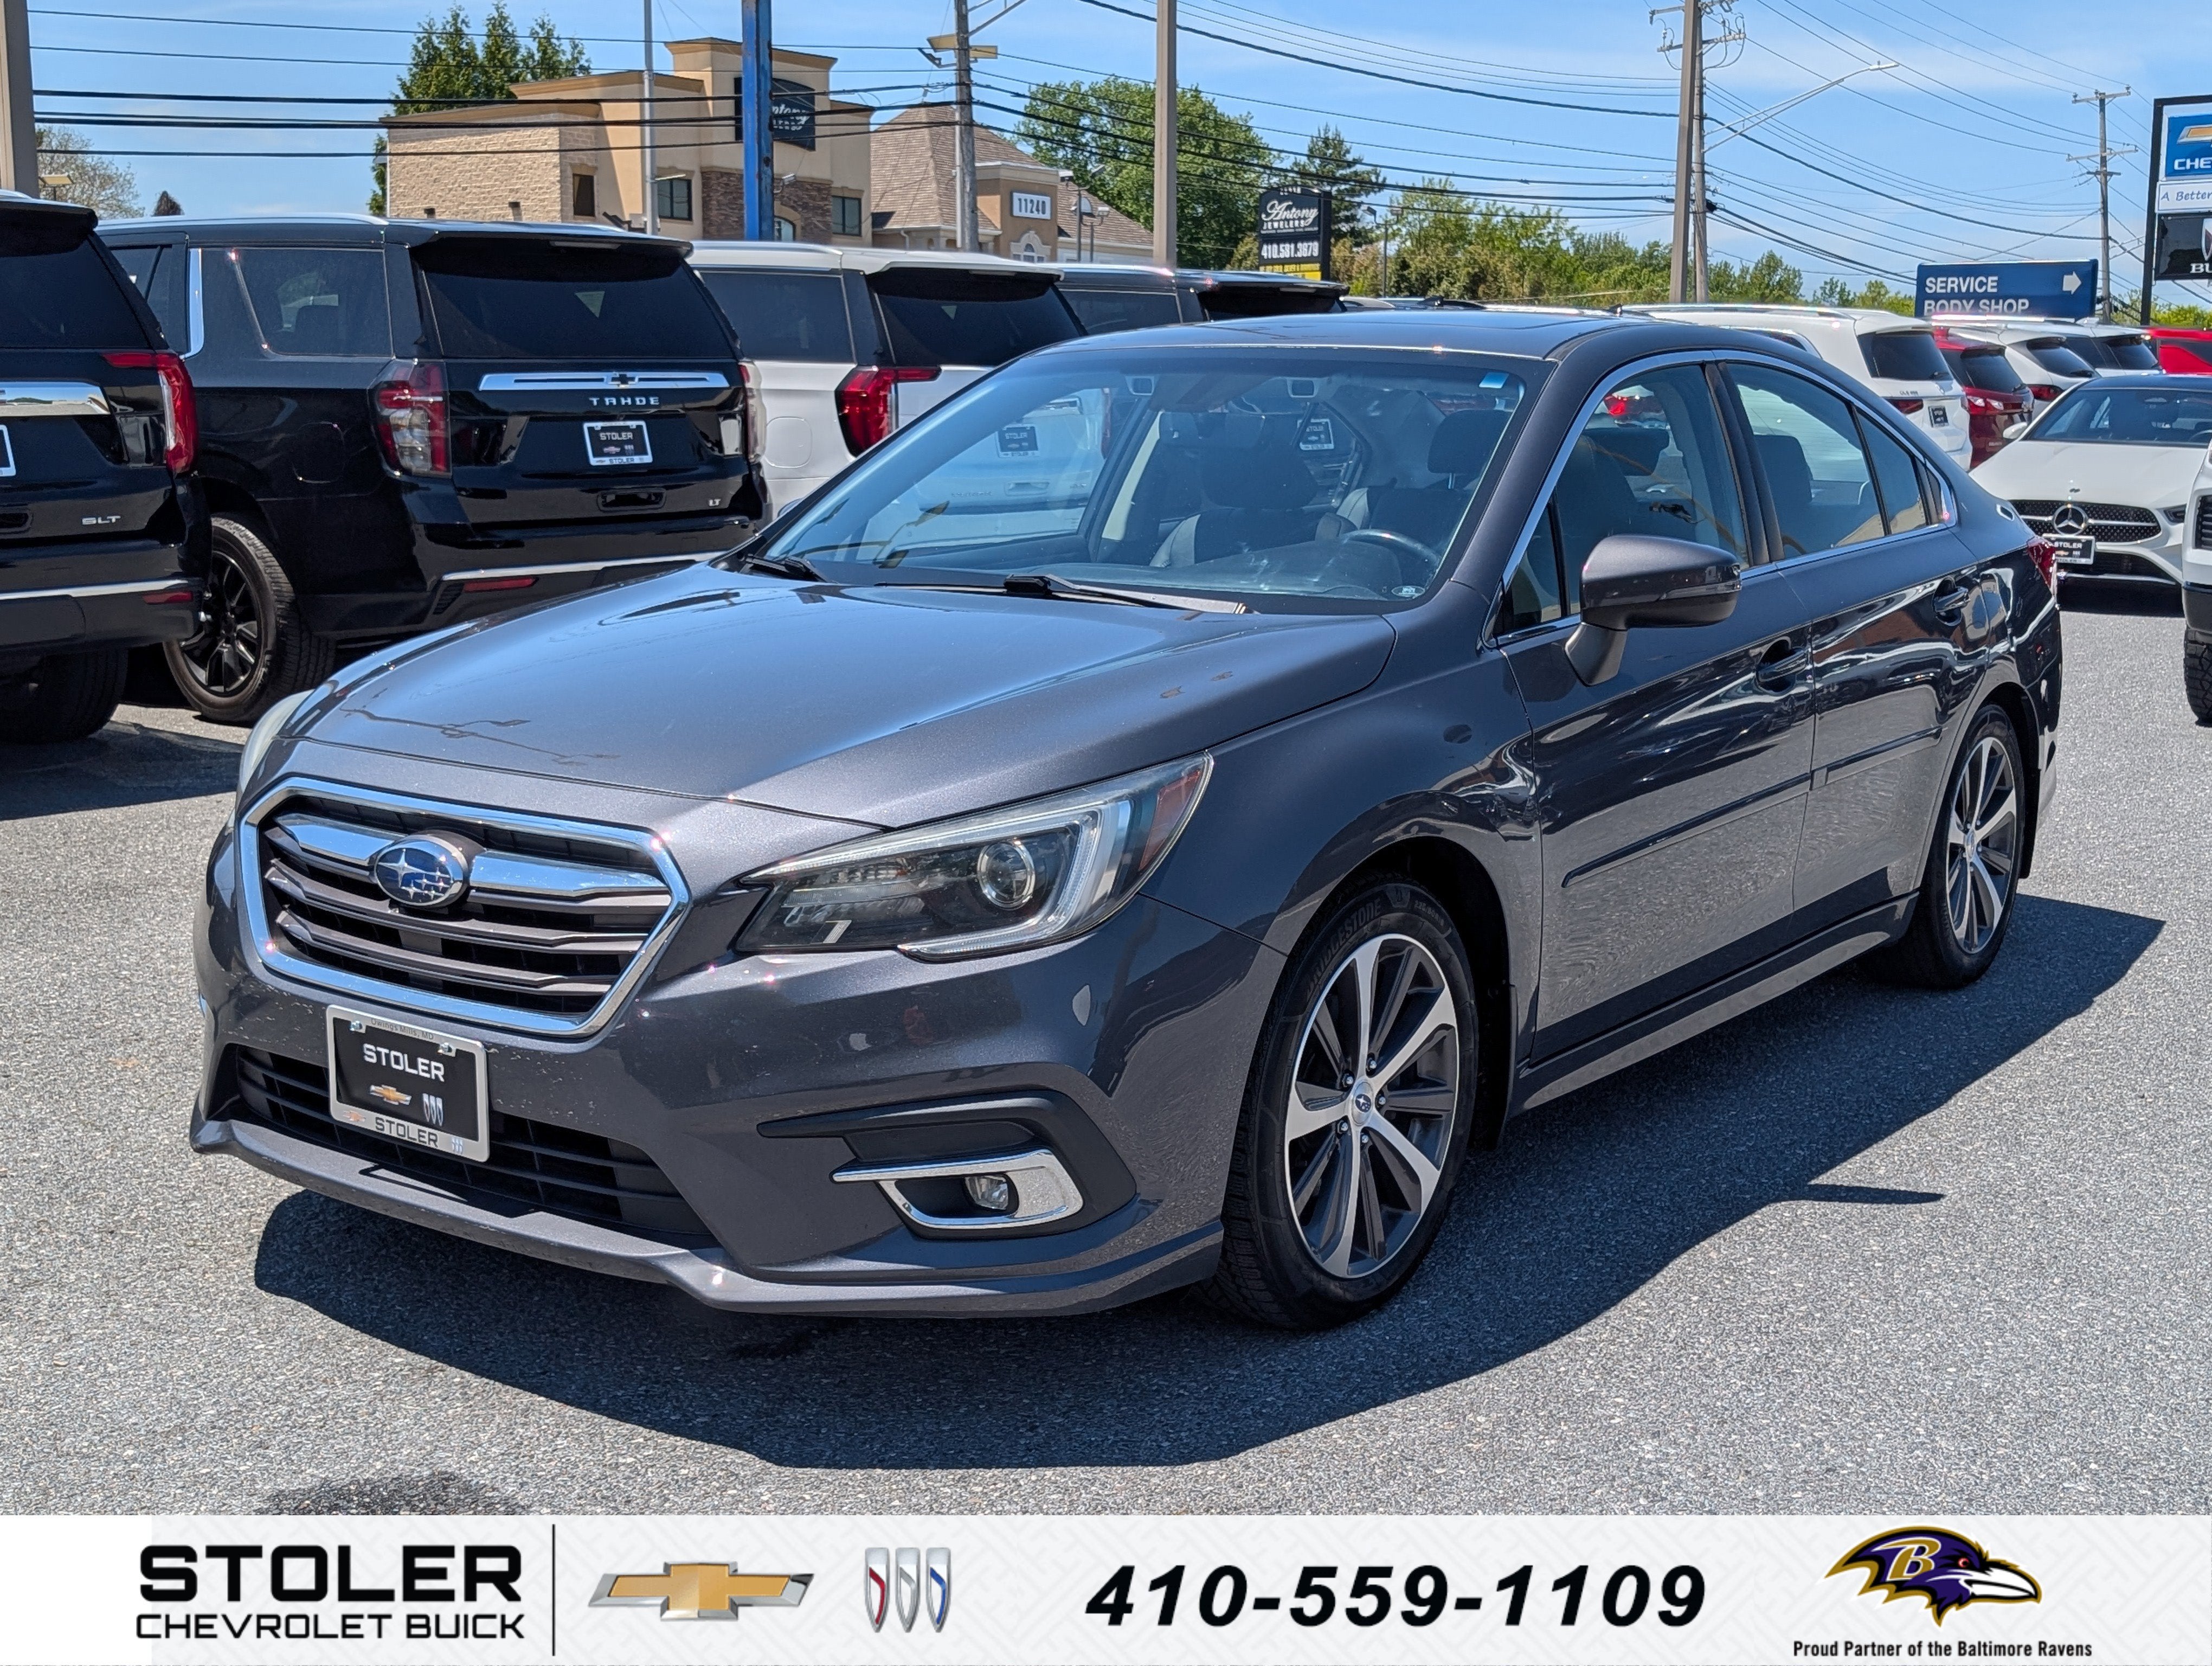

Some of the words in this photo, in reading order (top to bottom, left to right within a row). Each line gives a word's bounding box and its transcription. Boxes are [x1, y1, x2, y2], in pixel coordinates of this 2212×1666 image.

[2161, 193, 2170, 201] A
[2176, 190, 2212, 201] Better
[1018, 198, 1046, 215] 11240
[1261, 199, 1319, 226] Antony
[1263, 220, 1305, 229] JEWELERS
[1925, 276, 1999, 293] SERVICE
[1924, 299, 1975, 316] BODY
[1979, 298, 2029, 313] SHOP
[589, 396, 660, 406] TAHOE
[600, 432, 633, 440] STOLER
[82, 515, 121, 525] SLT
[371, 1019, 398, 1031] Owings
[422, 1031, 434, 1040] MD
[363, 1043, 445, 1082] STOLER
[375, 1117, 438, 1148] STOLER
